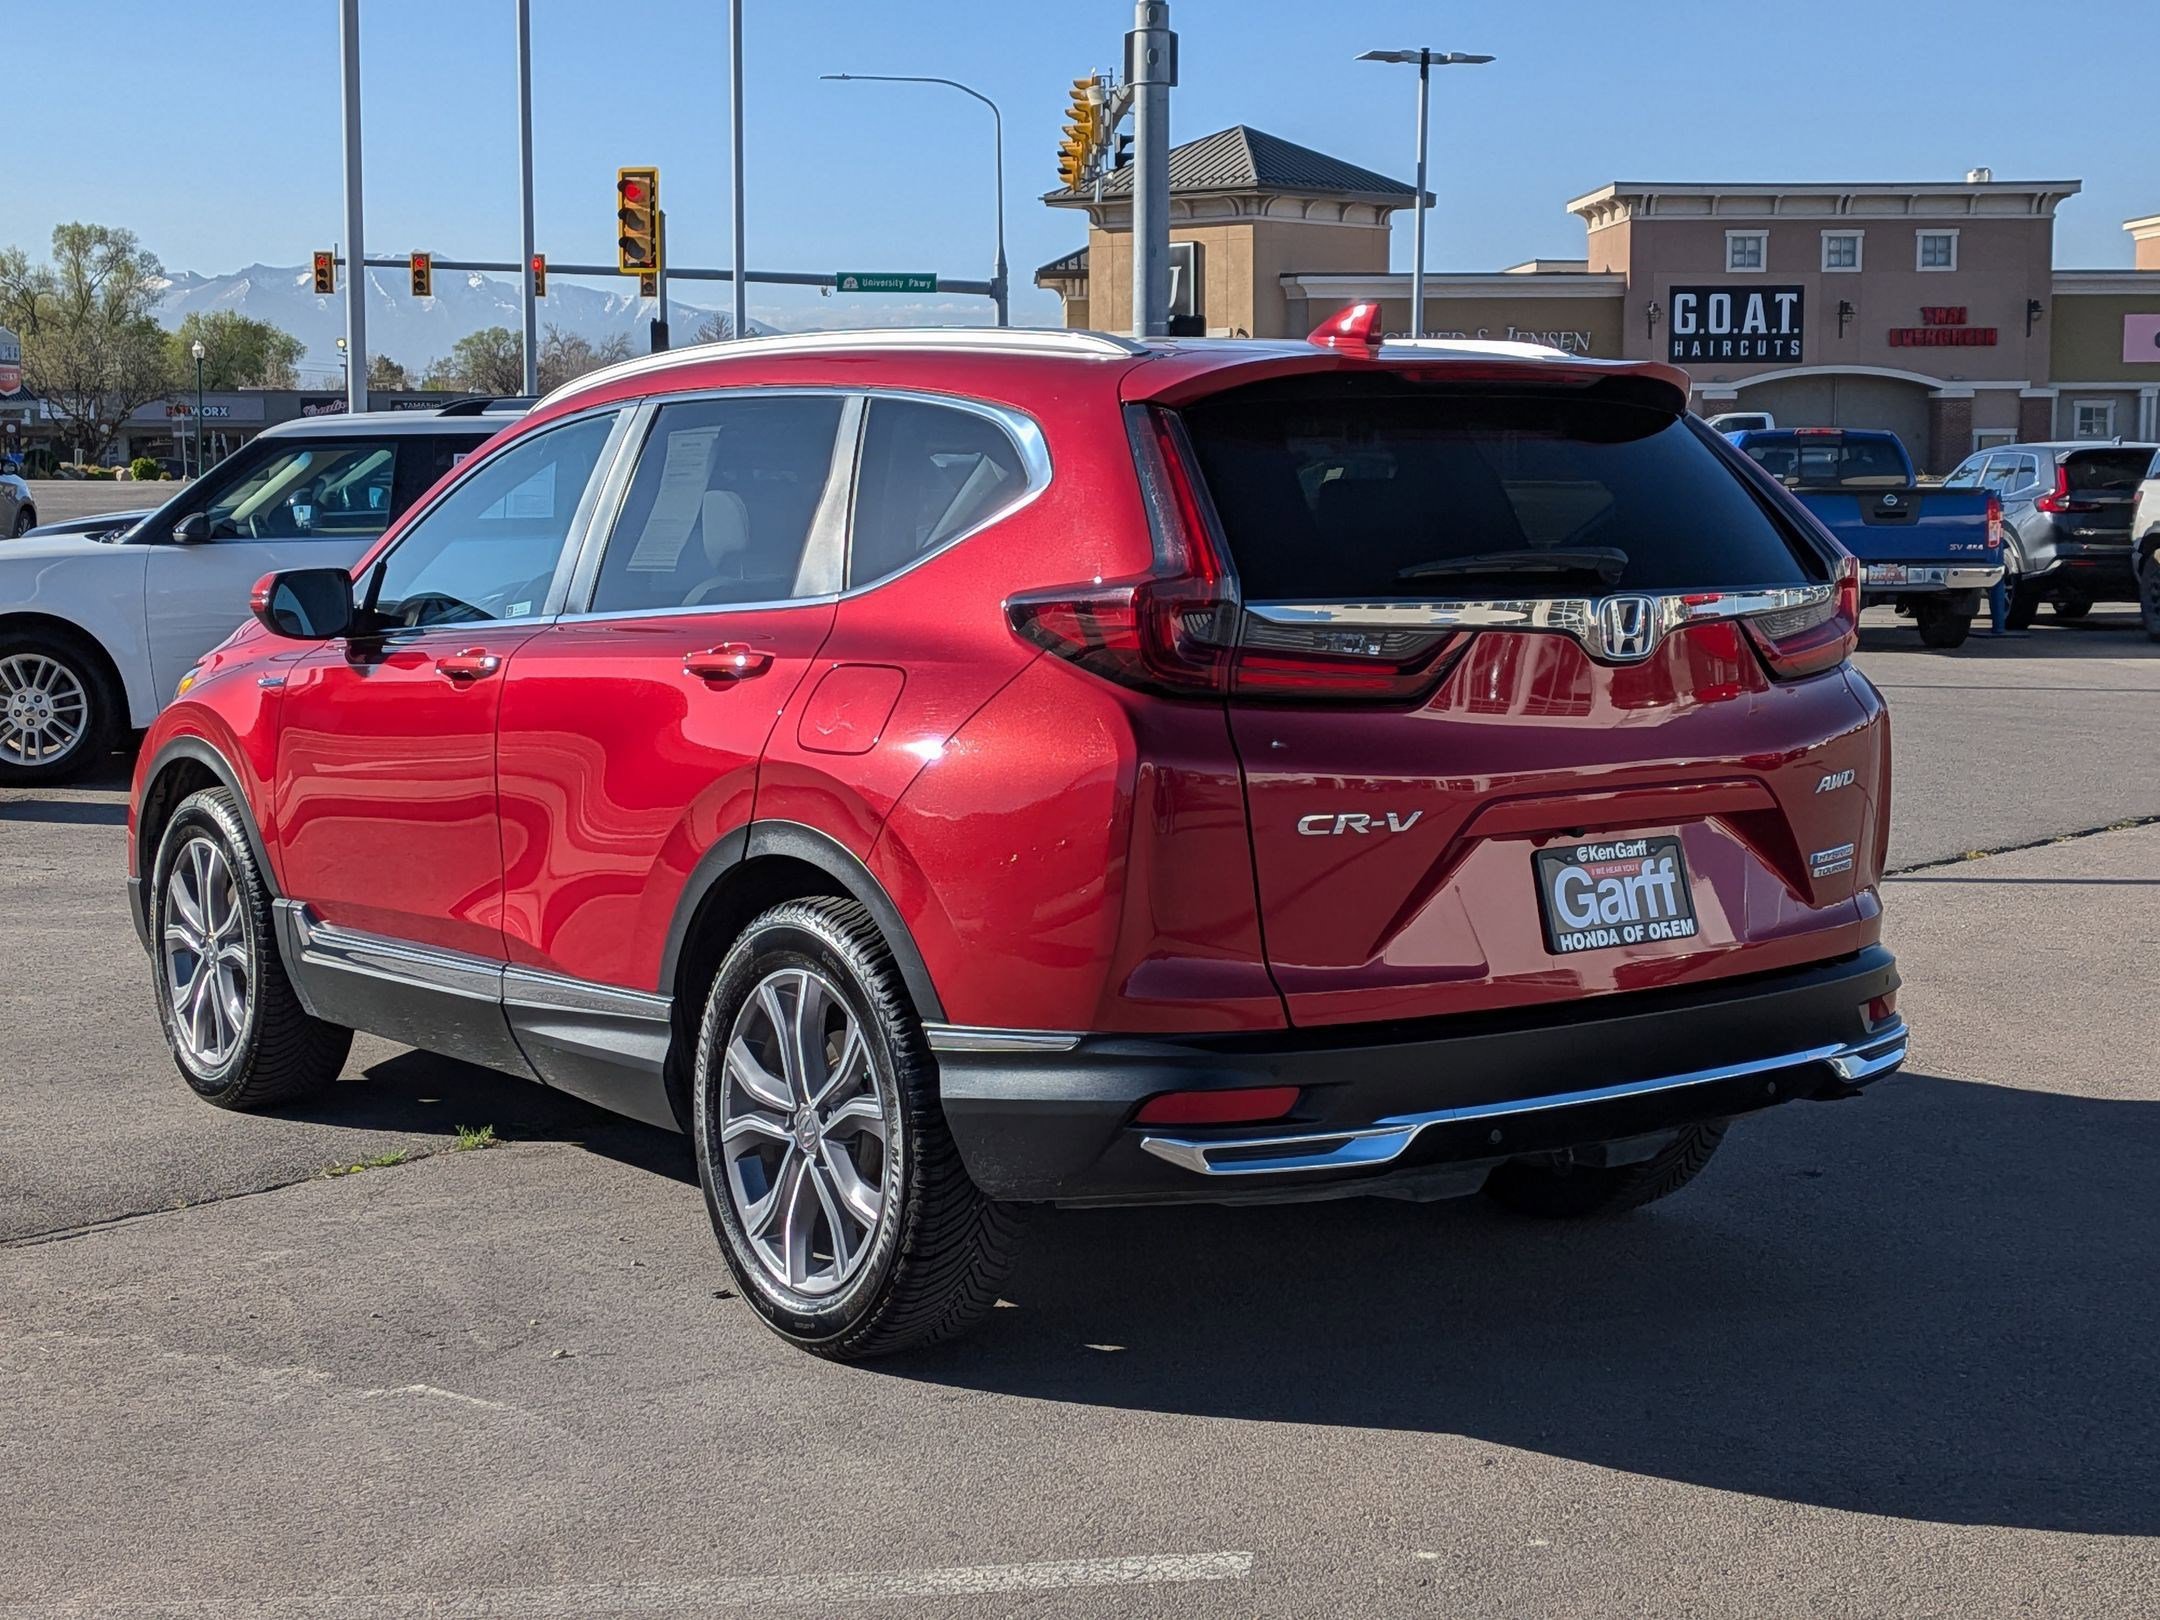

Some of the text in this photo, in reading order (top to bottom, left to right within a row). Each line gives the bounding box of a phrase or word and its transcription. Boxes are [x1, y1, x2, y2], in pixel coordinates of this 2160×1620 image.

[862, 278, 932, 289] University Pkwy
[1674, 293, 1800, 334] G.O.A.T.
[1674, 340, 1800, 356] HAIRCUTS
[1949, 543, 1964, 551] SV
[1815, 769, 1855, 793] AWD
[1297, 810, 1424, 836] CR-V
[1554, 857, 1677, 929] Garff
[1559, 918, 1695, 951] HONDA OF OREM
